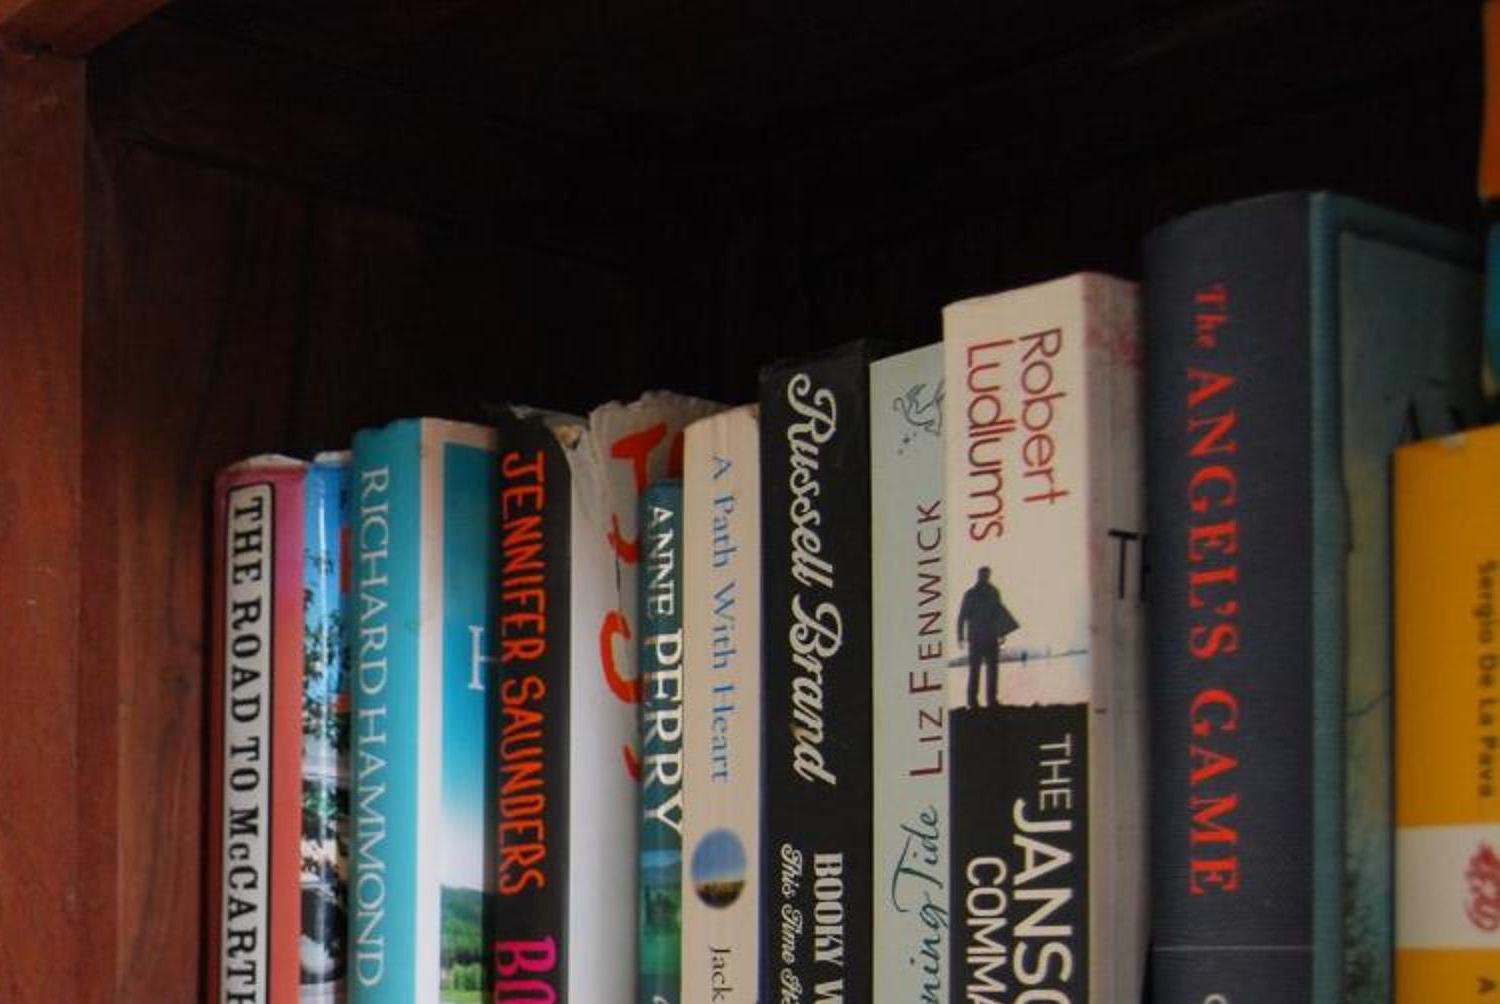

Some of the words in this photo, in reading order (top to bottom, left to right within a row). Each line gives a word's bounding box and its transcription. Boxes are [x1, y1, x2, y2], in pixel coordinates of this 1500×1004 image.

[1194, 285, 1228, 348] The
[712, 456, 732, 479] A
[1020, 328, 1069, 504] Robert
[712, 496, 737, 569] Path
[787, 373, 836, 588] Russell
[1188, 367, 1238, 660] ANGEL'S
[232, 497, 263, 584] THE
[359, 465, 388, 695] RICHARD
[503, 451, 545, 661] JENNIFER
[647, 506, 674, 617] ANNE
[712, 581, 737, 672] With
[909, 500, 943, 694] FENWICK
[229, 599, 262, 724] ROAD
[789, 595, 843, 785] Brand
[229, 738, 261, 788] TO
[501, 671, 546, 896] SAUNDERS
[643, 628, 684, 835] PERRY
[710, 682, 737, 784] Heart
[910, 707, 943, 776] LIZ
[1039, 734, 1072, 811] THE
[356, 709, 387, 987] HAMMOND
[1188, 689, 1239, 896] GAME
[781, 843, 802, 899] This
[814, 853, 843, 967] BOOKY
[891, 804, 944, 912] Tide
[708, 944, 736, 1002] Jack
[781, 903, 802, 964] Time
